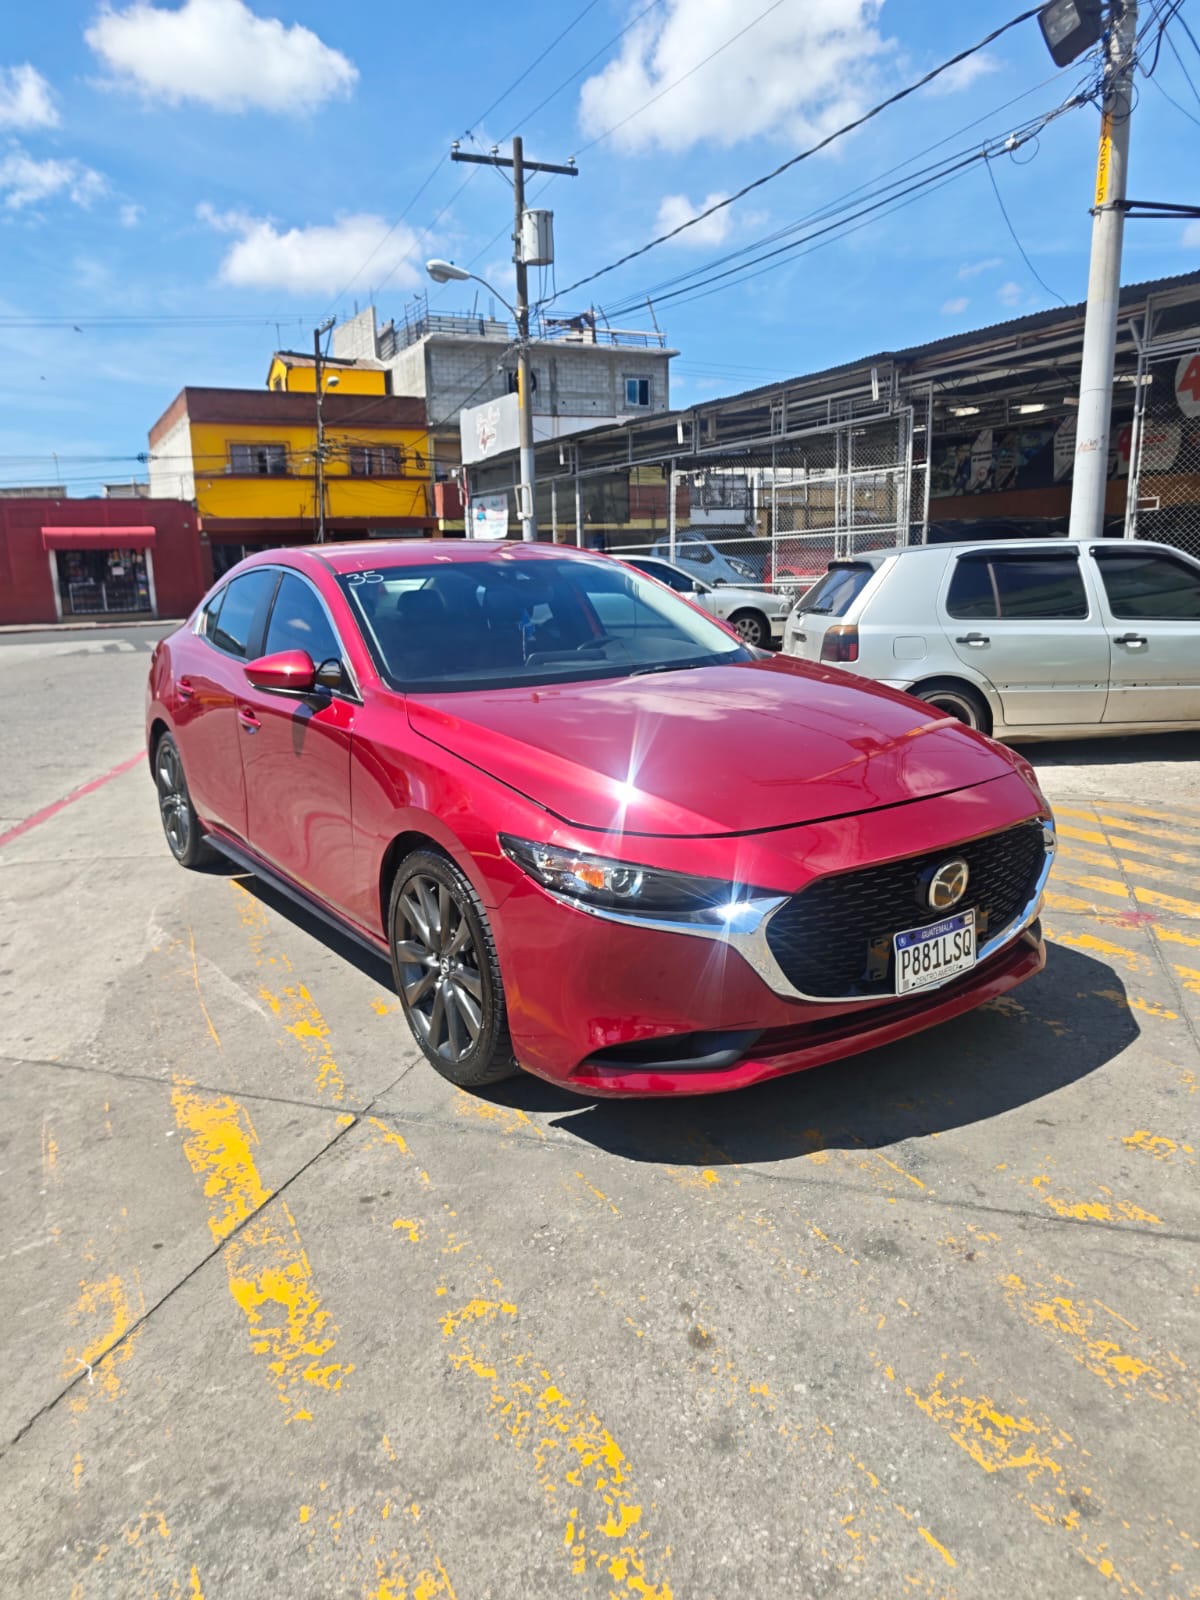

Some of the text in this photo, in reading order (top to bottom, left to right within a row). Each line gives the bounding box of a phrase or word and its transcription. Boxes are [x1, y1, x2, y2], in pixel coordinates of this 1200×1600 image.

[346, 570, 385, 586] 35
[921, 922, 953, 939] GUATEMALA
[902, 929, 971, 979] P881LSQ
